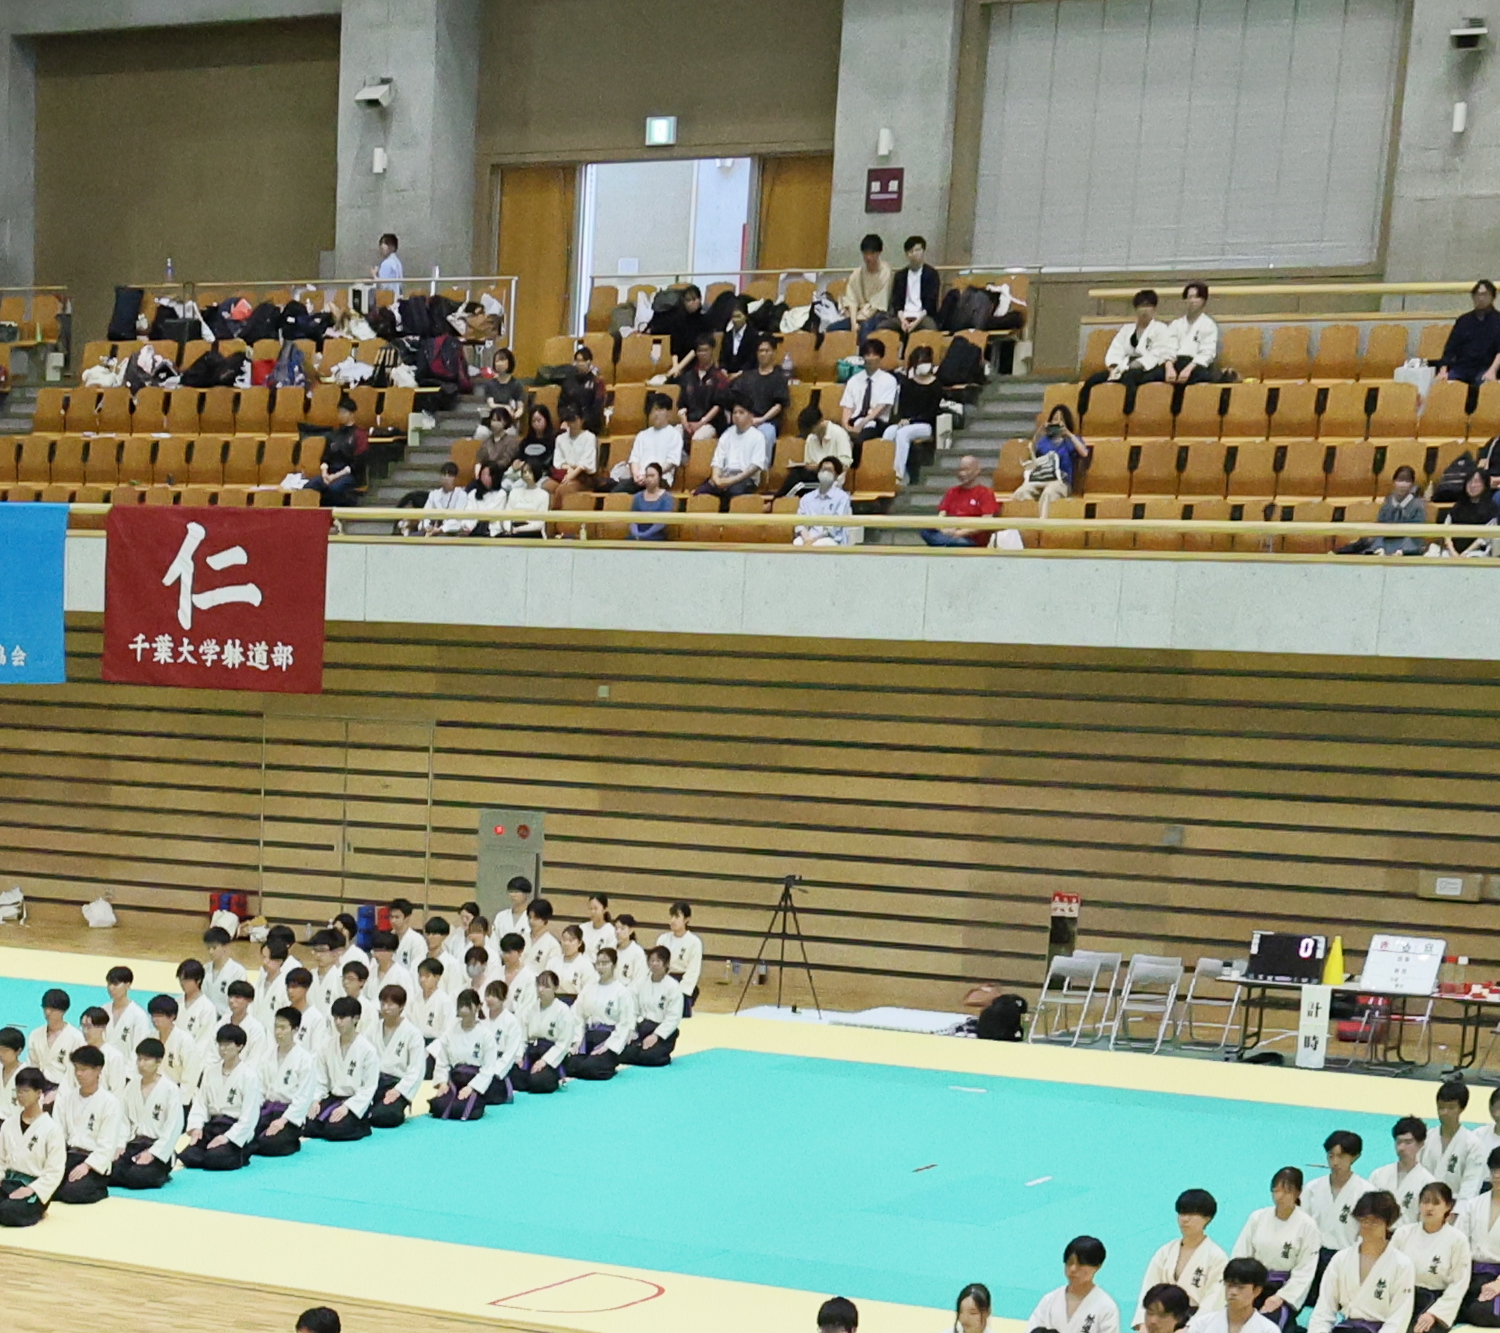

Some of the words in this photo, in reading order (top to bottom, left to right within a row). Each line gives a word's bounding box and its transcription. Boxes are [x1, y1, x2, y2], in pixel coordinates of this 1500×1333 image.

[161, 521, 263, 631] 仁
[128, 633, 295, 672] 千葉大学躰道部
[1299, 937, 1315, 958] 0
